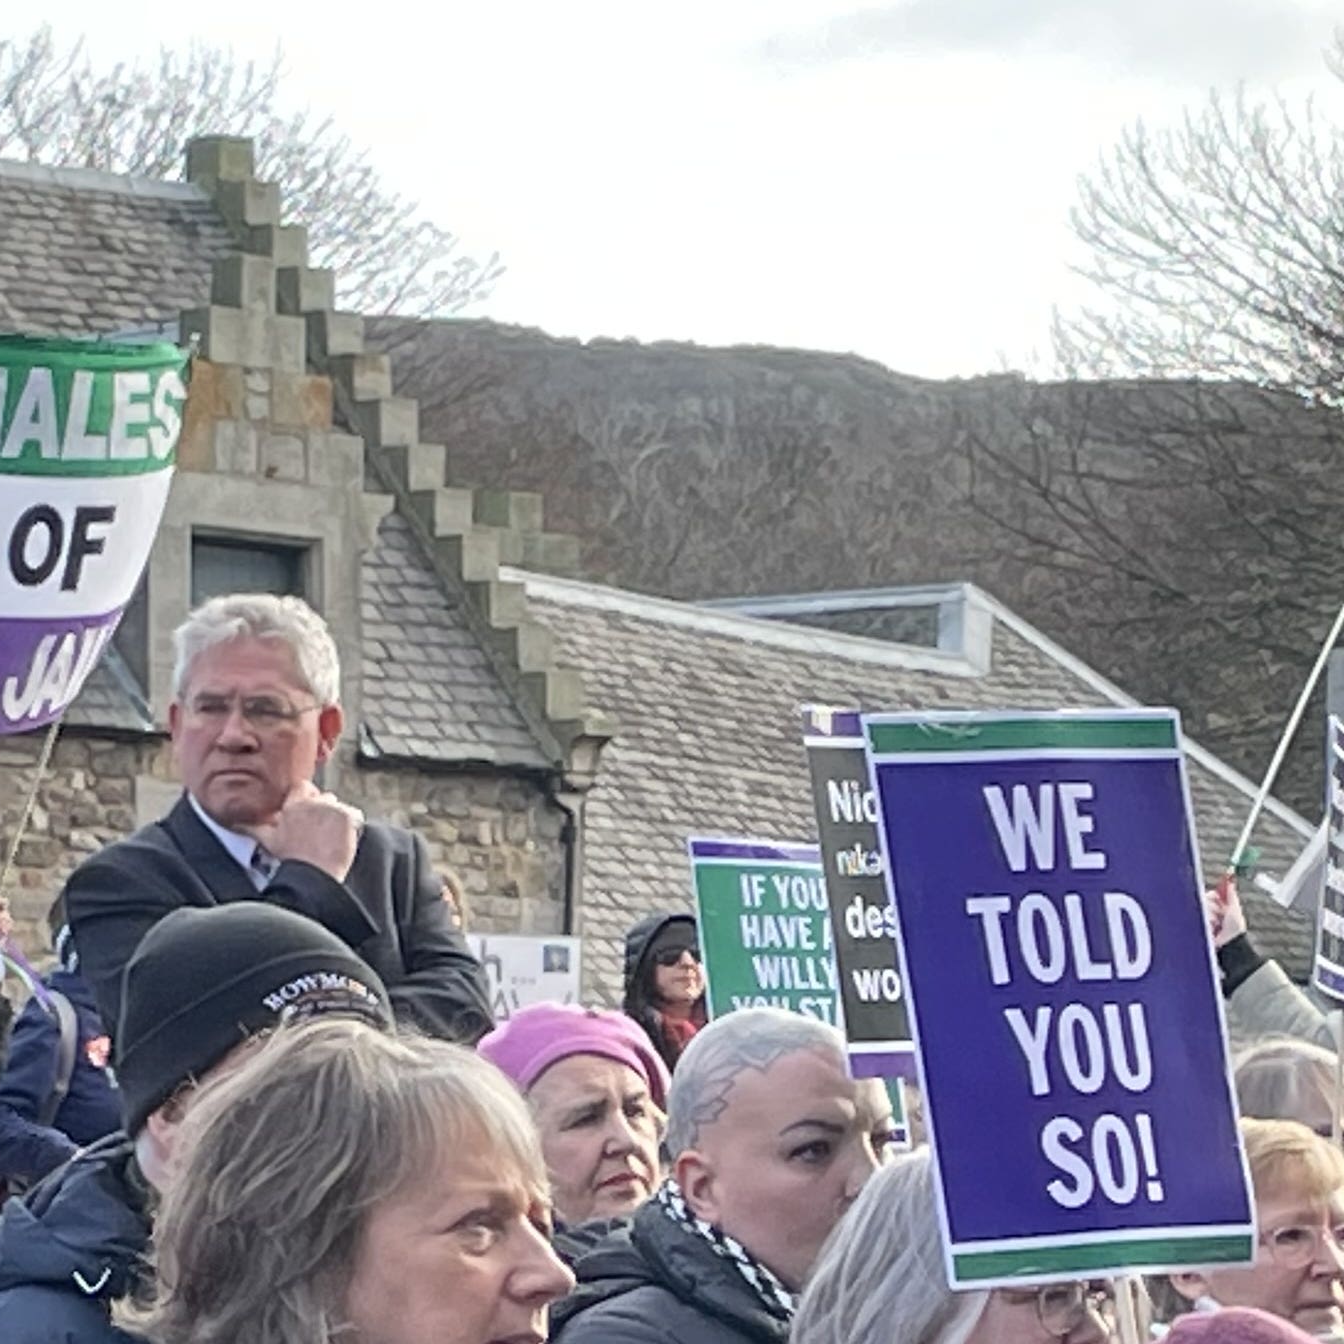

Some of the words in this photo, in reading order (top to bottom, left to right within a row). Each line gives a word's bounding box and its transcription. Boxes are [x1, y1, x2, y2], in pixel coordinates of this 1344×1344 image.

[8, 504, 115, 592] OF
[983, 782, 1106, 872] WE
[740, 873, 766, 908] IF
[772, 875, 827, 911] YOU
[740, 915, 817, 950] HAVE
[752, 954, 838, 990] WILLY
[967, 892, 1152, 986] TOLD
[852, 968, 902, 1002] wo
[1005, 1003, 1152, 1096] YOU
[1042, 1114, 1164, 1208] SO!
